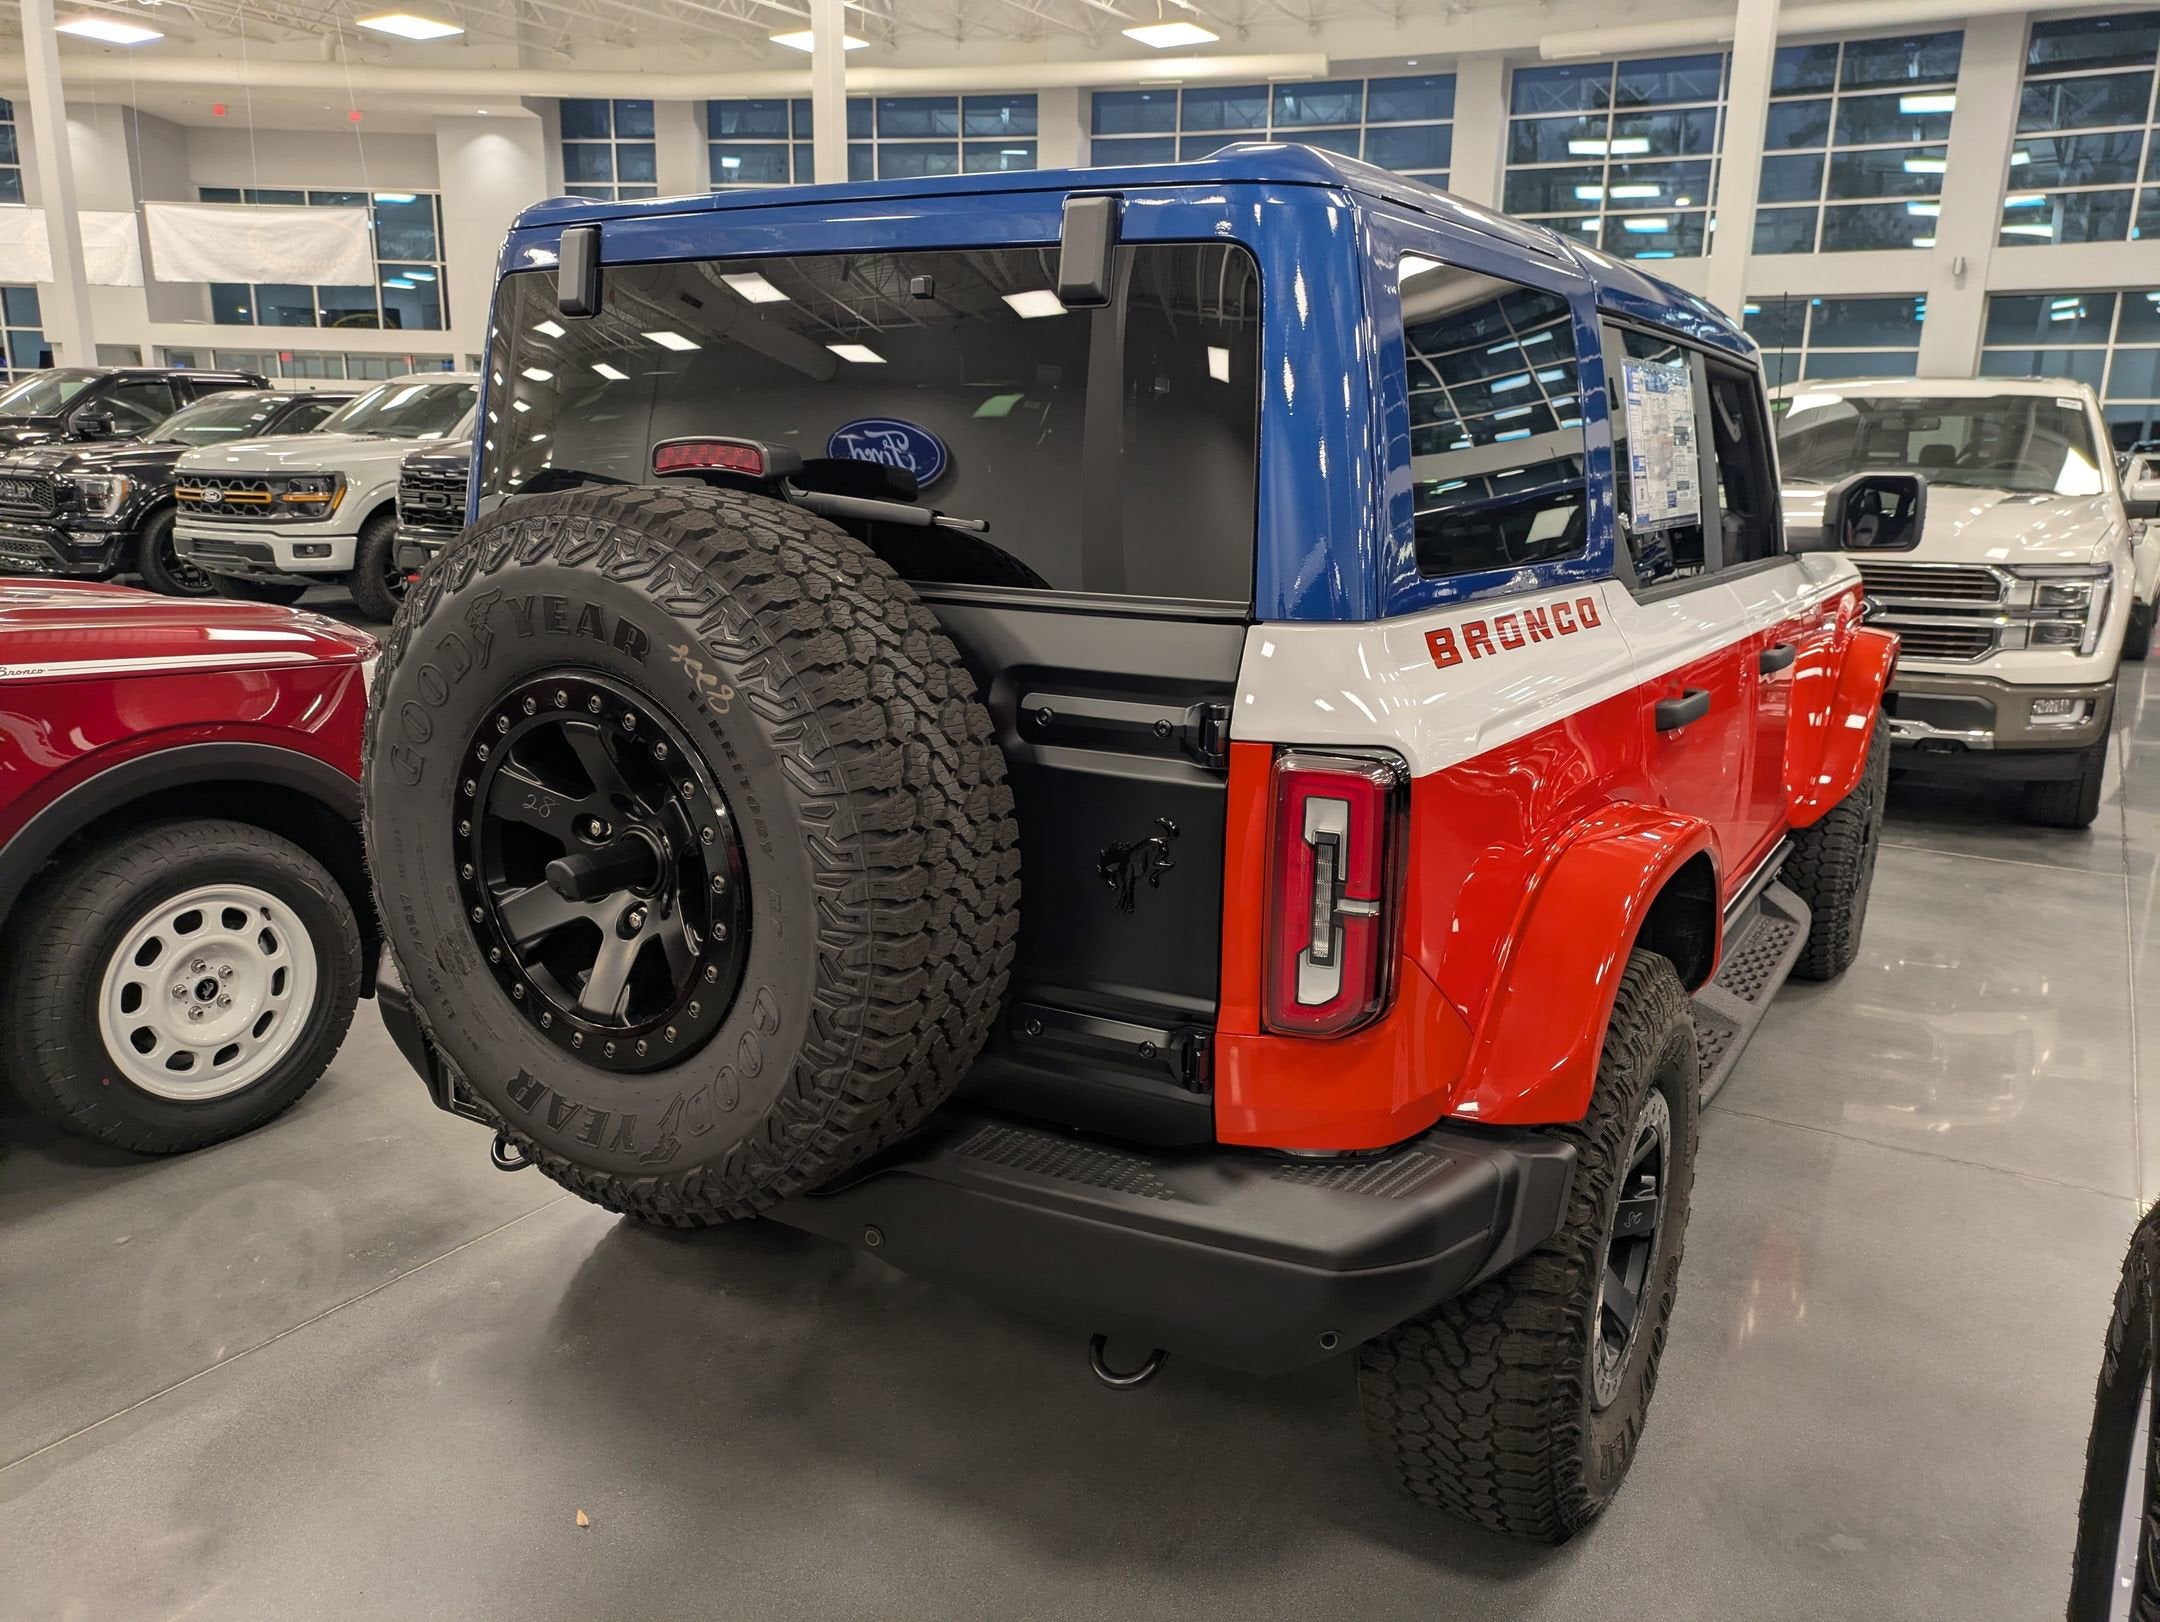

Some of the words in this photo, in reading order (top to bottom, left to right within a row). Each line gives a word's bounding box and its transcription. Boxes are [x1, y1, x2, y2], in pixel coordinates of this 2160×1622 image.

[1424, 596, 1602, 670] BRONCO
[0, 666, 46, 678] Bronco
[687, 686, 775, 862] TERRITORY
[521, 793, 561, 818] 28
